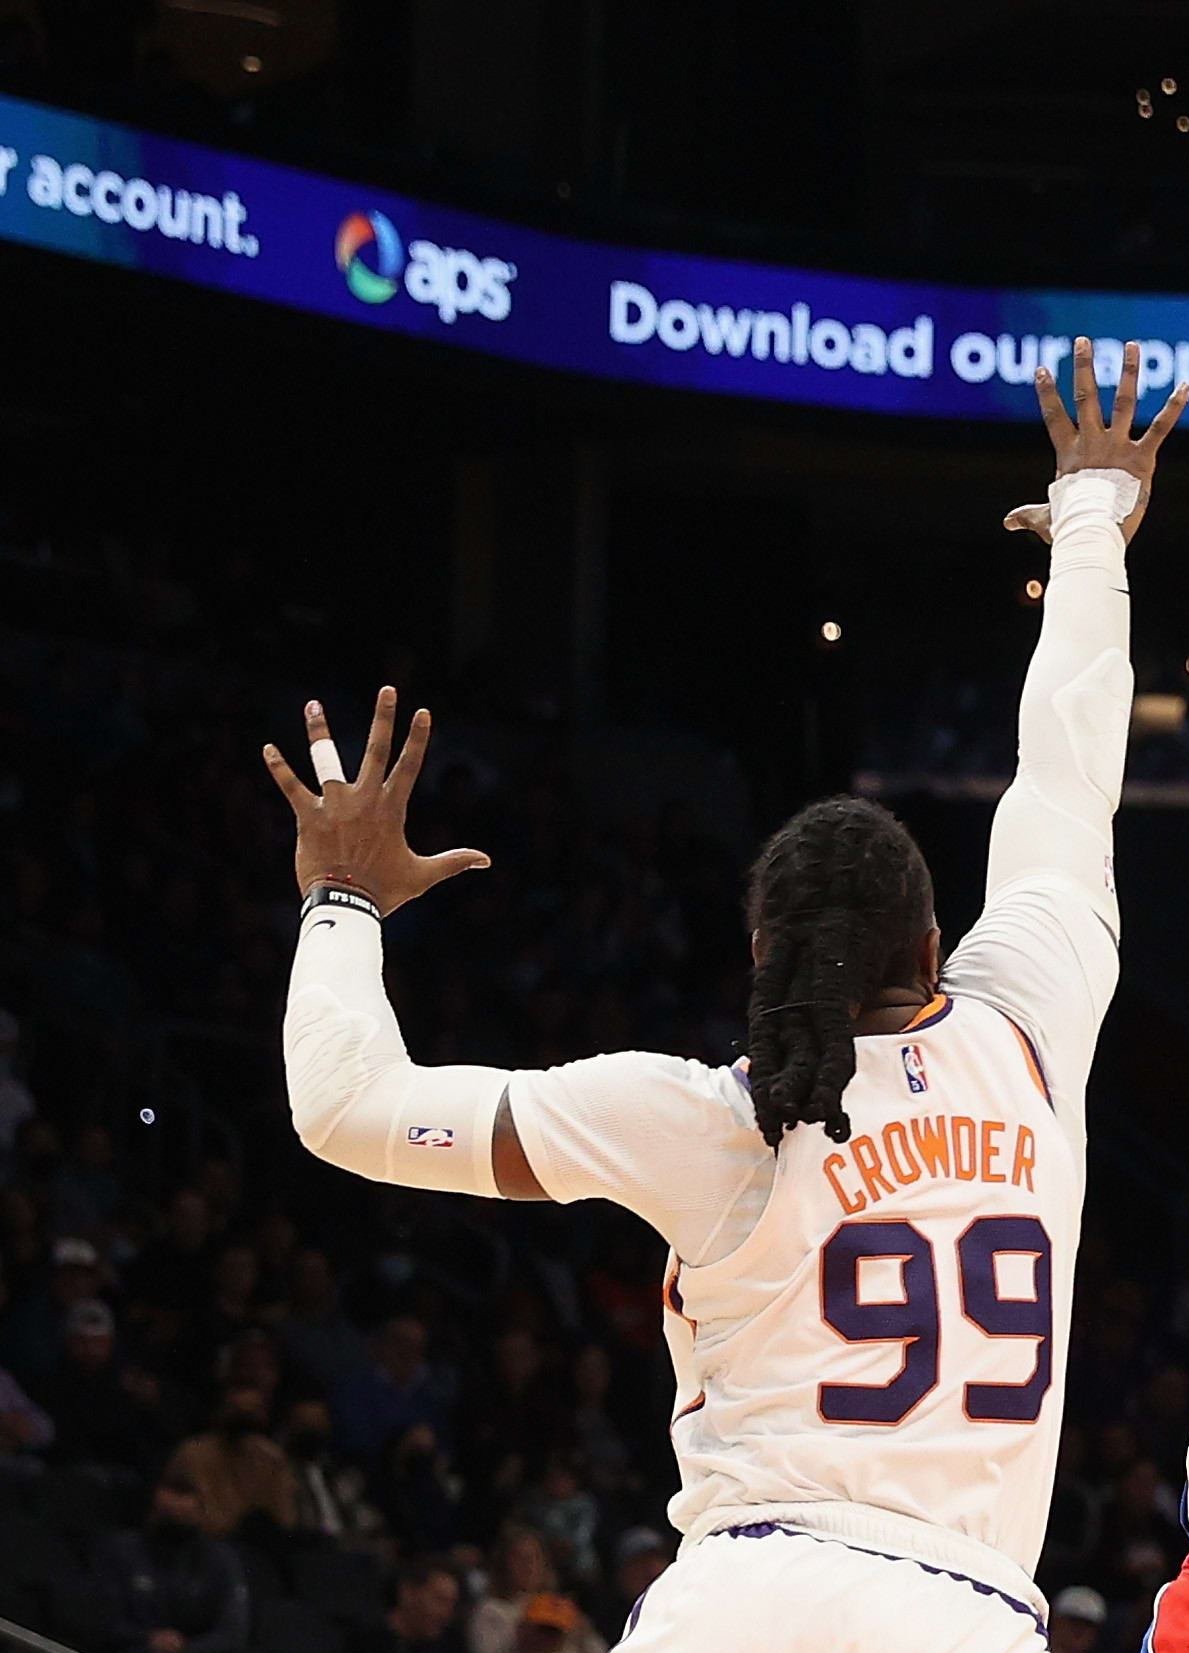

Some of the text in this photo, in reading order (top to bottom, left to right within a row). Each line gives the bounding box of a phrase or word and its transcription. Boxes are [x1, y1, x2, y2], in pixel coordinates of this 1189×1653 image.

[28, 156, 260, 257] account.
[404, 239, 513, 323] aps
[610, 282, 934, 379] Download
[950, 332, 1071, 384] our
[823, 1115, 1037, 1216] CROWDER
[816, 1213, 1053, 1427] 99
